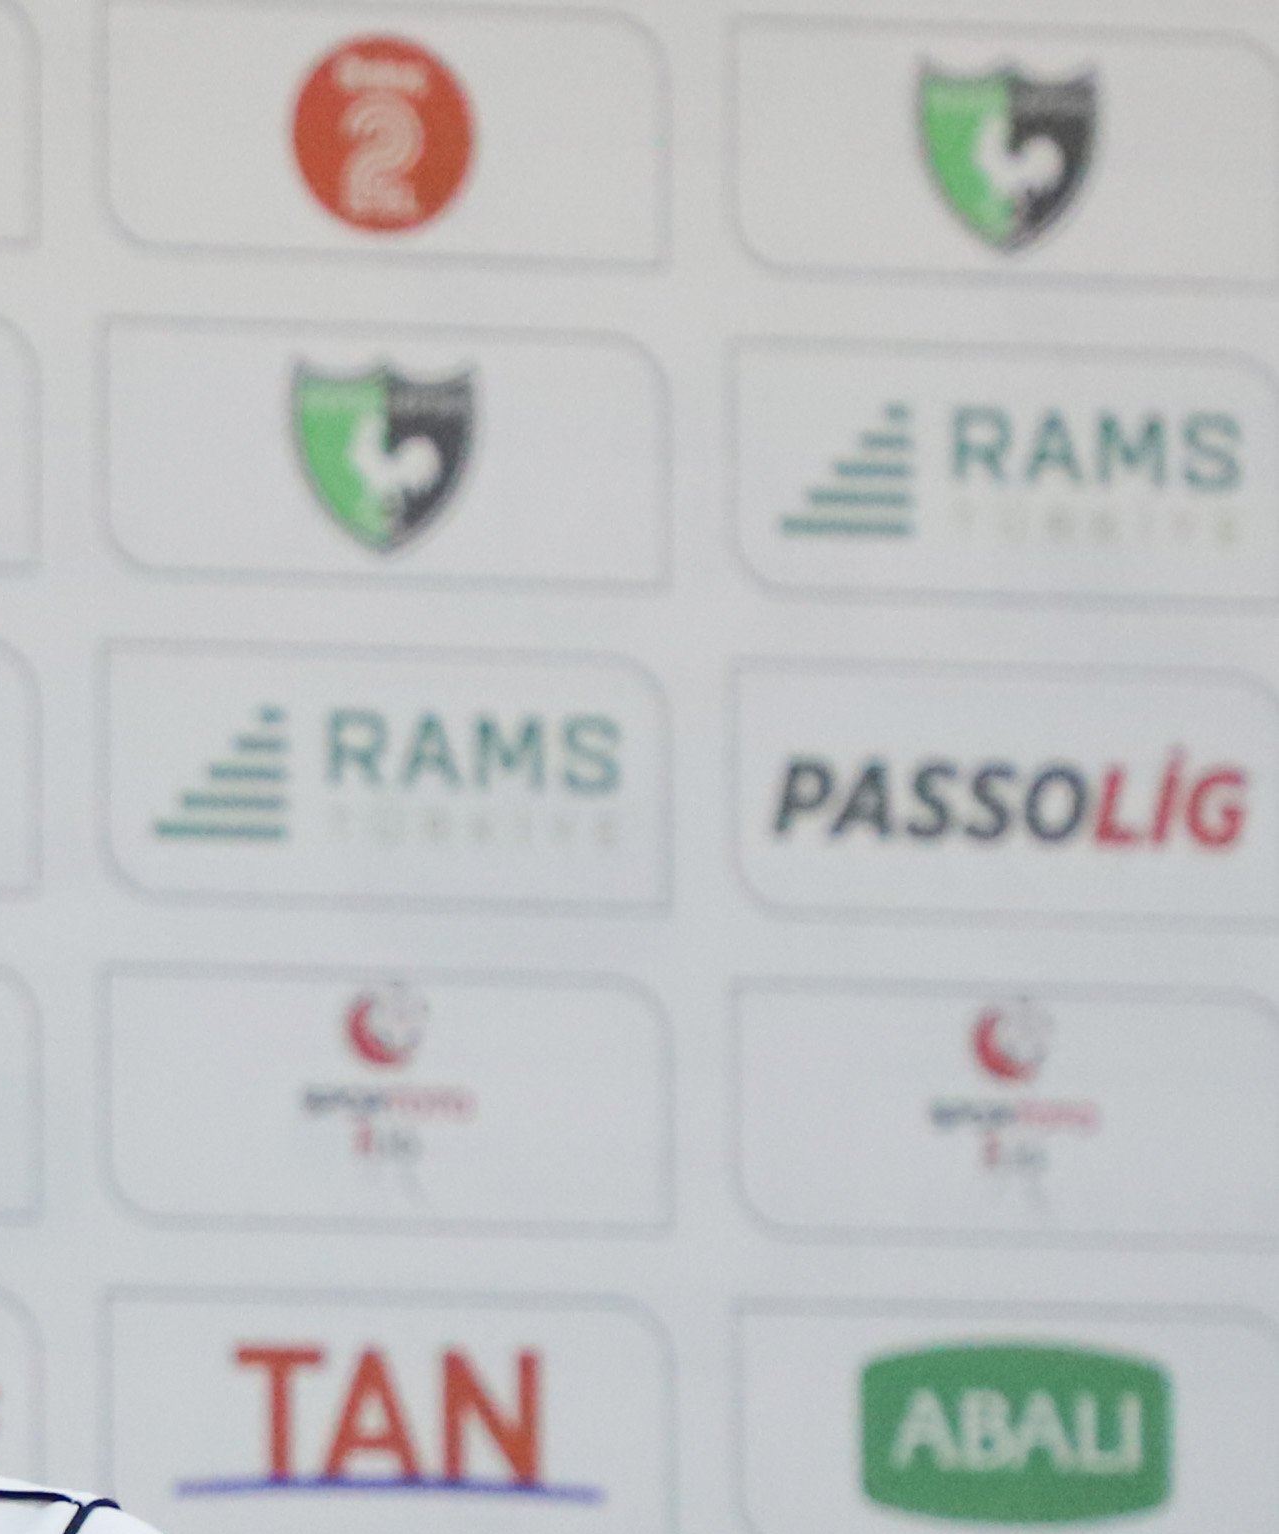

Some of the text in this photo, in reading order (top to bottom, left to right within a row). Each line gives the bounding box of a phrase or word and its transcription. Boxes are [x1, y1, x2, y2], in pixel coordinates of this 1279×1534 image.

[950, 404, 1242, 494] RAMS
[327, 707, 622, 796] RAMS
[233, 1344, 542, 1482] TAN
